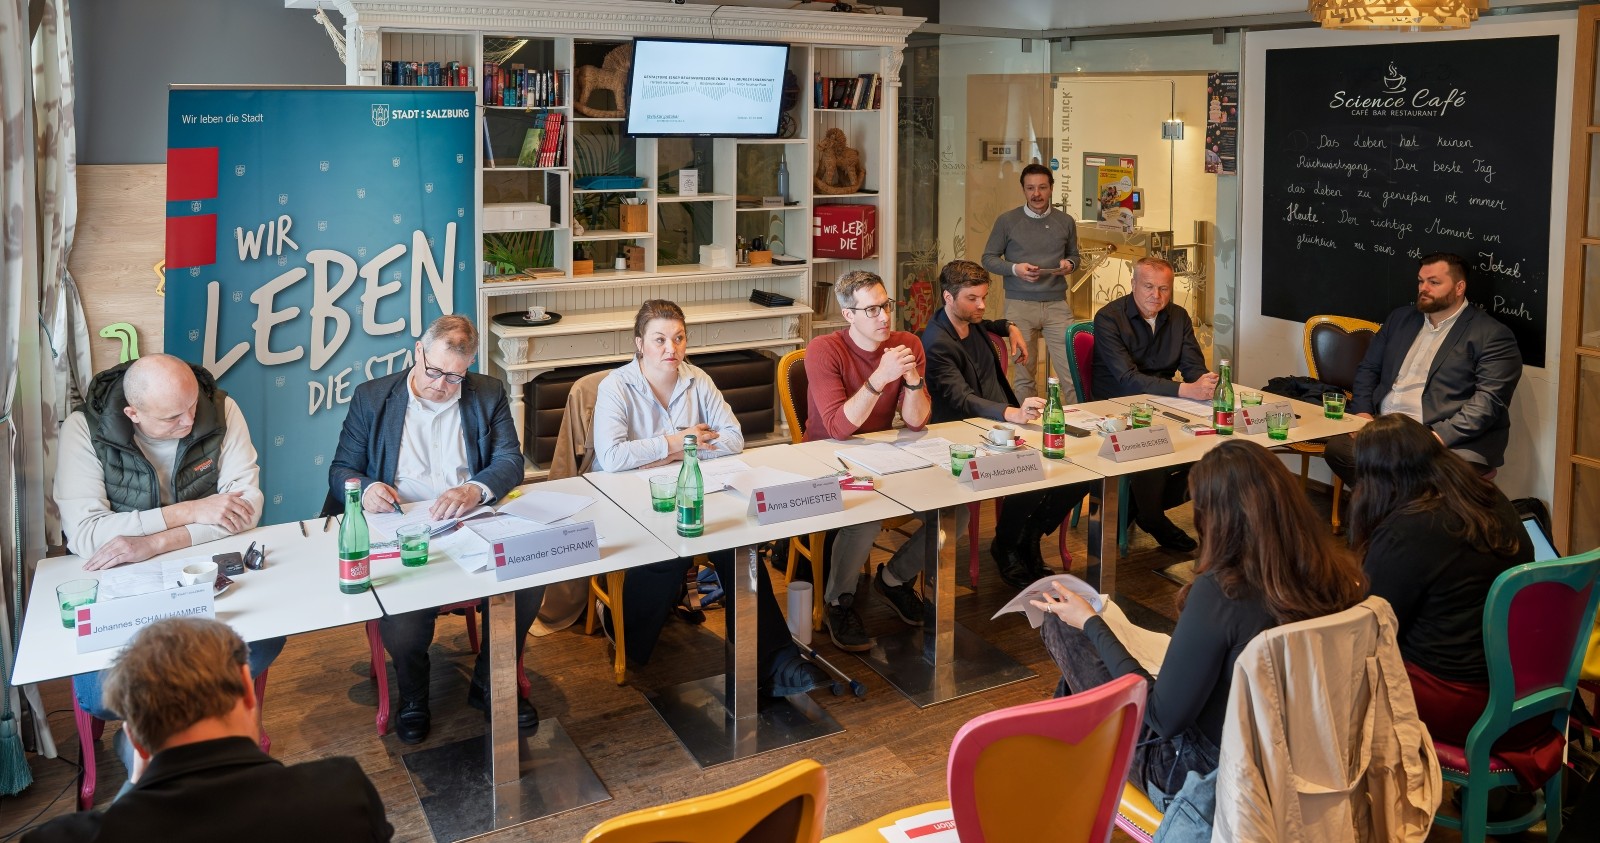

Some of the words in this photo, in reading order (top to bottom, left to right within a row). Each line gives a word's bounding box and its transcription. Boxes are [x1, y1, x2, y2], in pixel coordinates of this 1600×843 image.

[1329, 90, 1405, 109] Science
[1412, 88, 1467, 116] Café
[182, 114, 197, 124] Wir
[200, 114, 223, 124] leben
[225, 113, 240, 123] die
[241, 112, 264, 123] Stadt
[391, 109, 419, 120] STADT
[426, 108, 470, 119] SALZBURG
[1351, 108, 1369, 116] CAFÉ
[1317, 134, 1340, 150] Das
[1399, 133, 1420, 148] hat
[1394, 157, 1419, 172] Der
[1433, 160, 1464, 173] beste
[1472, 158, 1497, 184] Tag
[1287, 183, 1306, 195] das
[1357, 189, 1371, 199] zu
[1445, 191, 1459, 205] ist
[1469, 194, 1507, 211] immer
[823, 224, 839, 234] WIR
[1337, 209, 1360, 227] Der
[1370, 219, 1413, 240] richtige
[1424, 217, 1475, 240] Moment
[1482, 233, 1501, 244] um
[236, 214, 299, 261] WIR
[840, 237, 858, 250] DIE
[1354, 241, 1365, 251] zu
[1373, 243, 1396, 256] sein
[1407, 247, 1423, 260] ist
[203, 221, 457, 381] LEBEN
[307, 367, 353, 416] DIE
[364, 348, 416, 382] STA
[1121, 442, 1141, 451] Dominik
[1140, 437, 1169, 448] BUECKERS
[980, 467, 1016, 479] Kay-Michael
[1016, 463, 1039, 474] DANKL
[767, 502, 788, 511] Anna
[789, 492, 838, 508] SCHIESTER
[507, 549, 549, 565] Alexander
[550, 539, 595, 556] SCHRANK
[93, 620, 133, 634] Johannes
